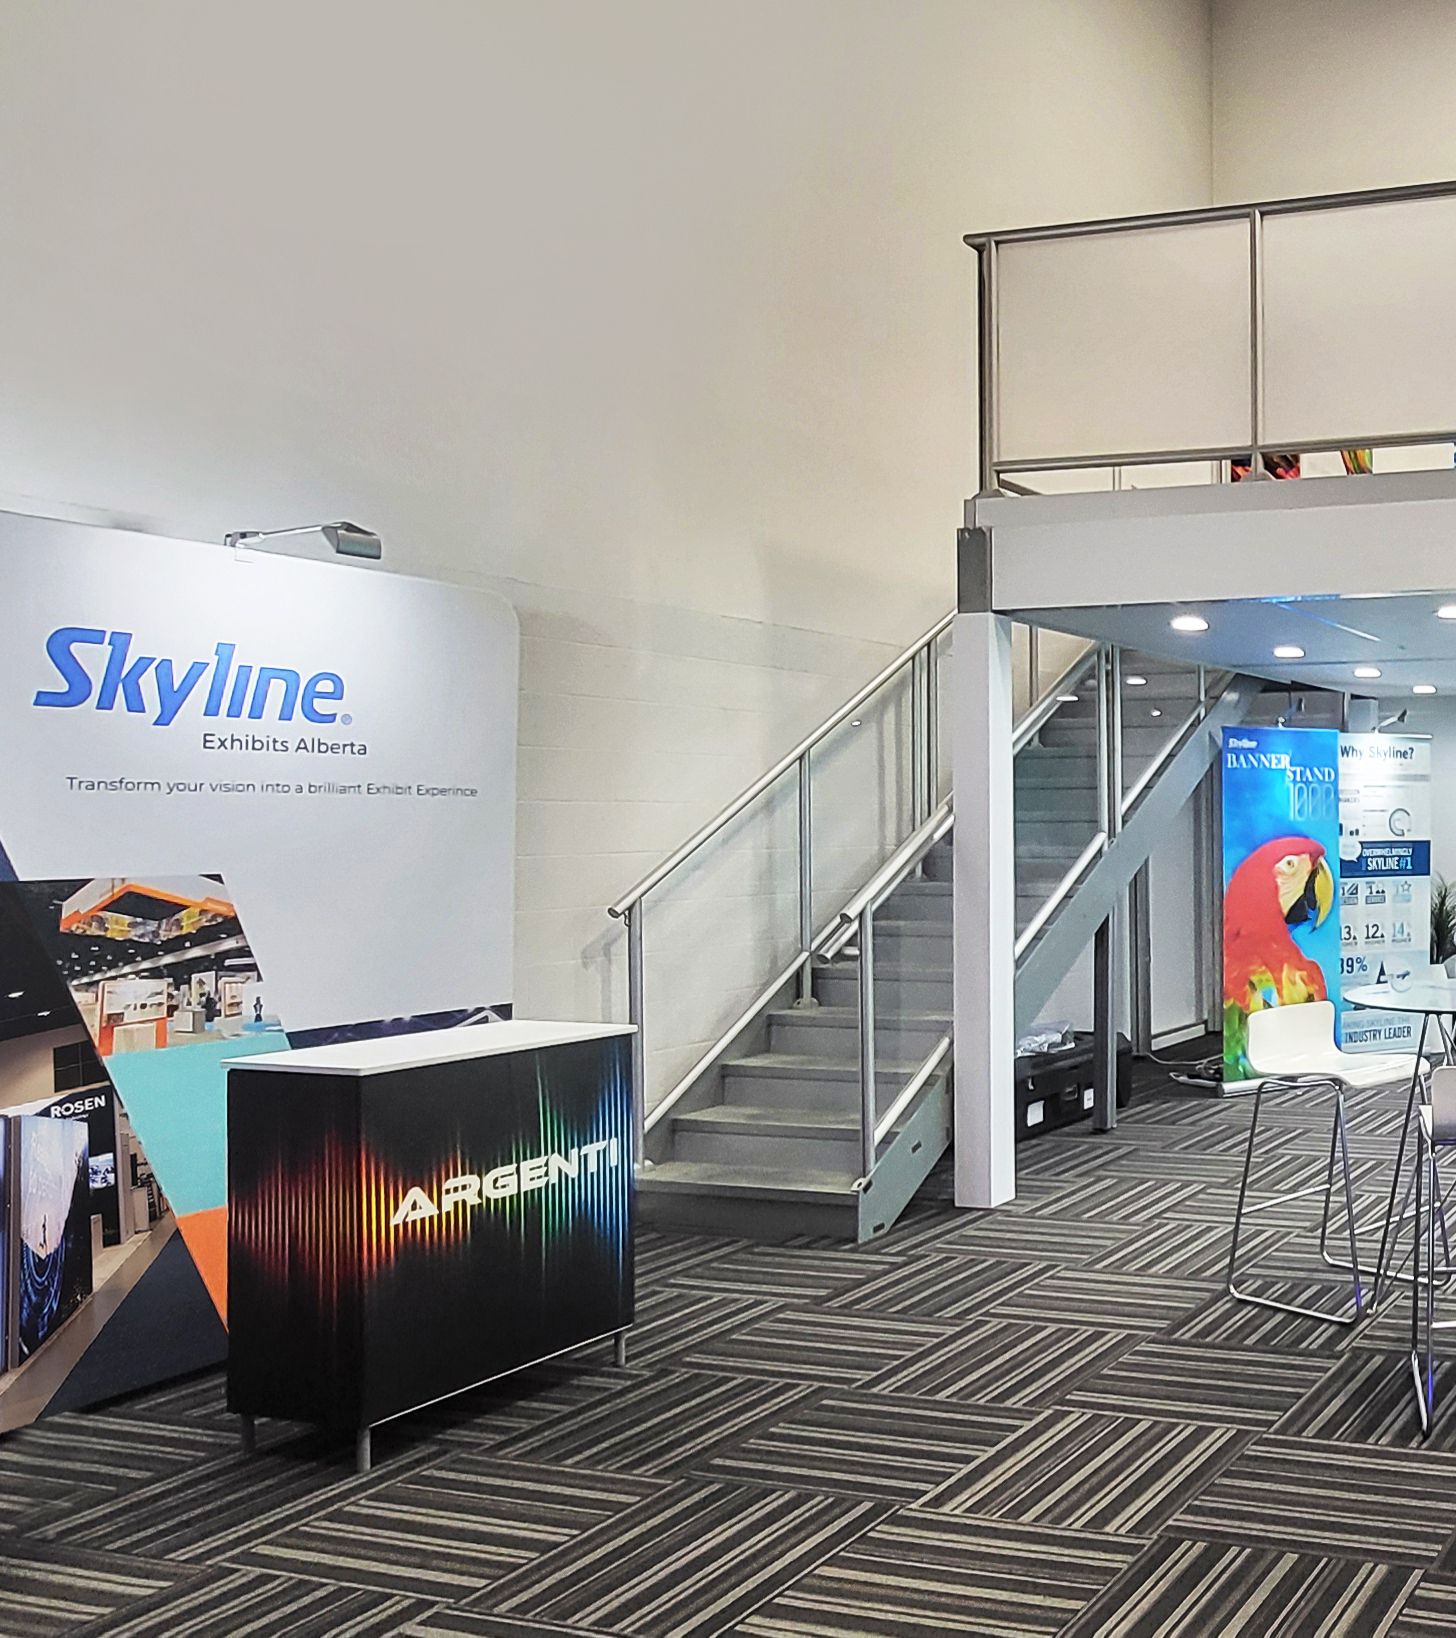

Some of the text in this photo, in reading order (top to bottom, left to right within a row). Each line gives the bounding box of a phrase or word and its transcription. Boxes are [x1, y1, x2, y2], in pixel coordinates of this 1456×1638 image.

[32, 626, 346, 726] Skyline
[202, 733, 368, 756] Exhibits Alberta
[1340, 745, 1414, 761] Why Skyline?
[1227, 753, 1291, 770] BANNER
[1286, 766, 1335, 782] STAND
[66, 777, 161, 793] Transform
[166, 780, 205, 795] your
[209, 781, 255, 793] vision
[260, 781, 291, 794] into
[295, 784, 304, 794] a
[308, 782, 362, 795] brilliant
[367, 783, 412, 796] Exhibit
[1288, 783, 1334, 821] 1000
[1367, 856, 1413, 871] SKYLINE #1
[1365, 924, 1380, 940] 12
[1345, 1025, 1412, 1044] INDUSTRY LEADER
[51, 1094, 106, 1118] ROSEN
[390, 1137, 618, 1227] ARGENTI
